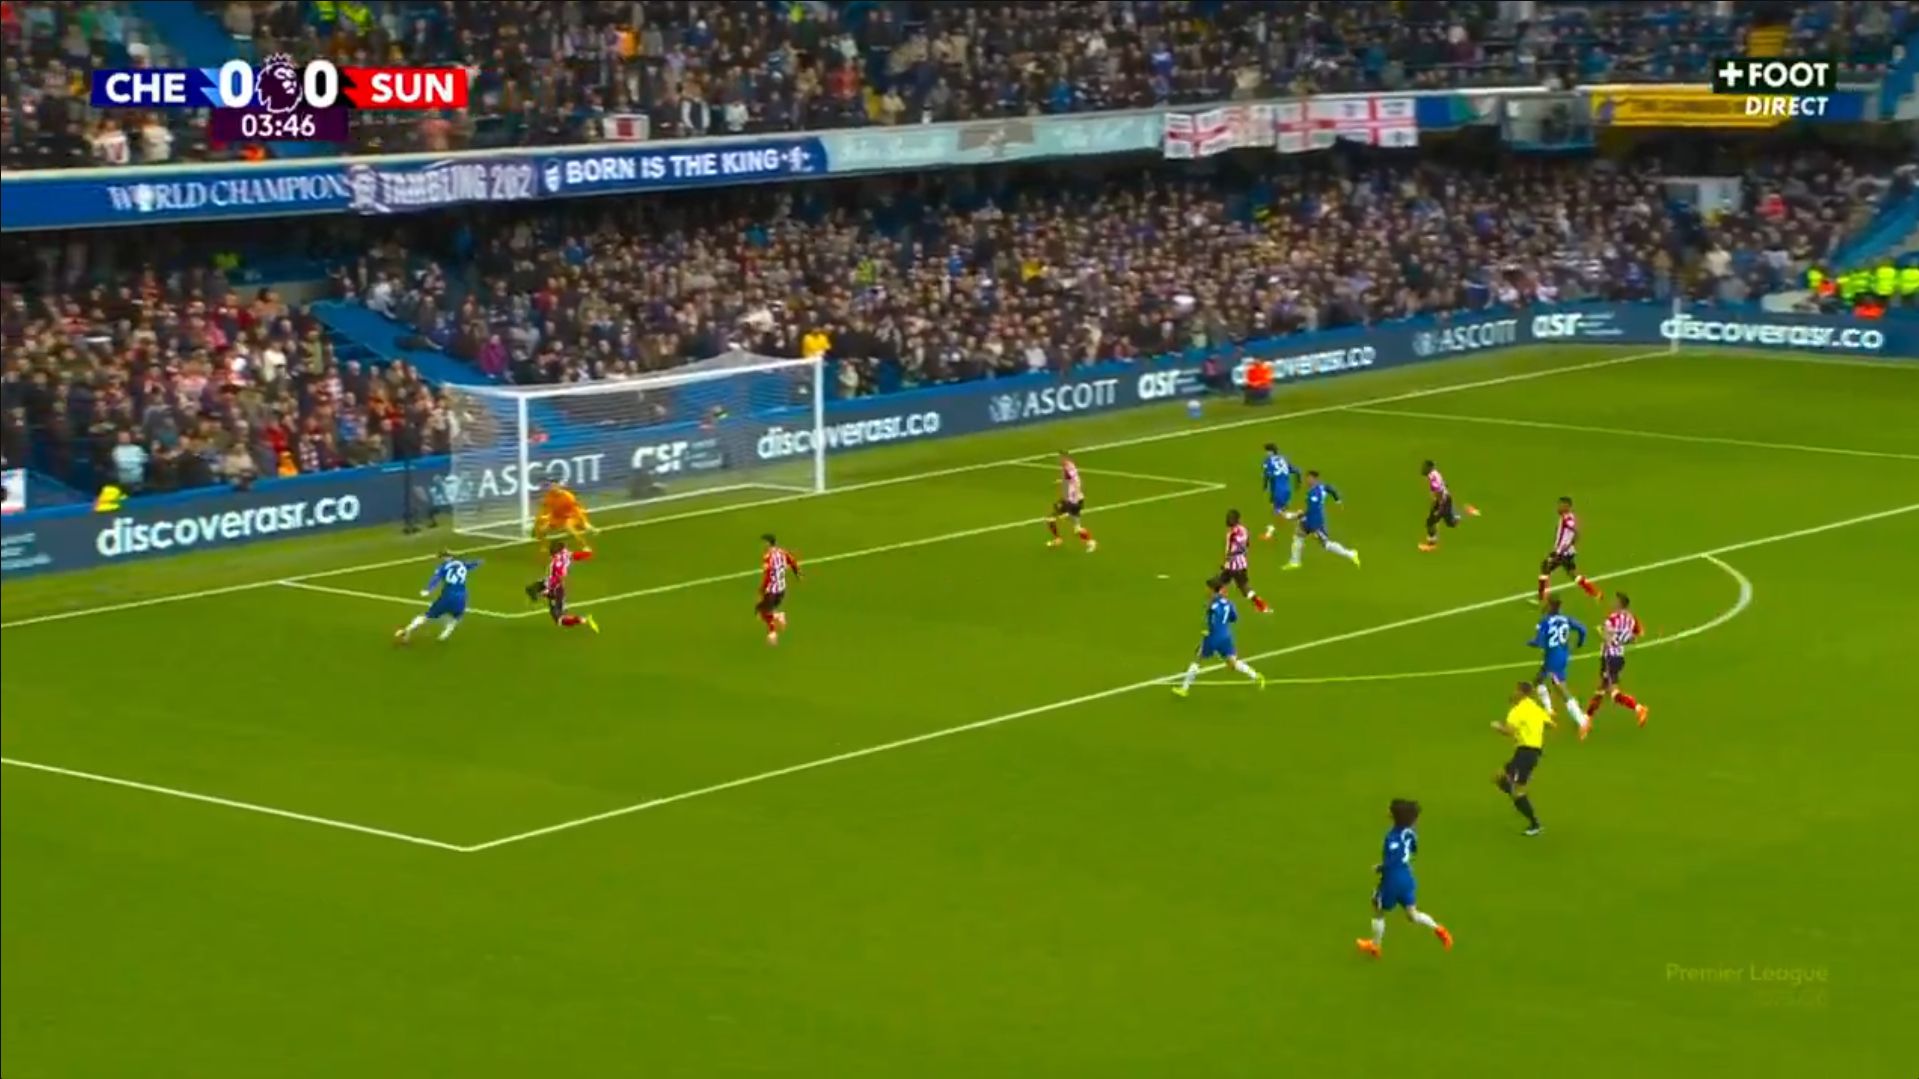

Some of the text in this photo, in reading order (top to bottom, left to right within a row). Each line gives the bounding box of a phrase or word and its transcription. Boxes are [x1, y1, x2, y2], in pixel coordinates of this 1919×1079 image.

[567, 149, 779, 184] BORN IS THE KING
[1440, 319, 1518, 351] ASCOTT
[1532, 313, 1582, 338] asr
[1660, 313, 1884, 348] discoverasr.co
[1022, 379, 1119, 418] ASCOTT
[1138, 370, 1180, 399] asr
[477, 453, 606, 499] ASCOTT
[97, 495, 361, 556] discoverasr.co
[1548, 623, 1570, 648] 20
